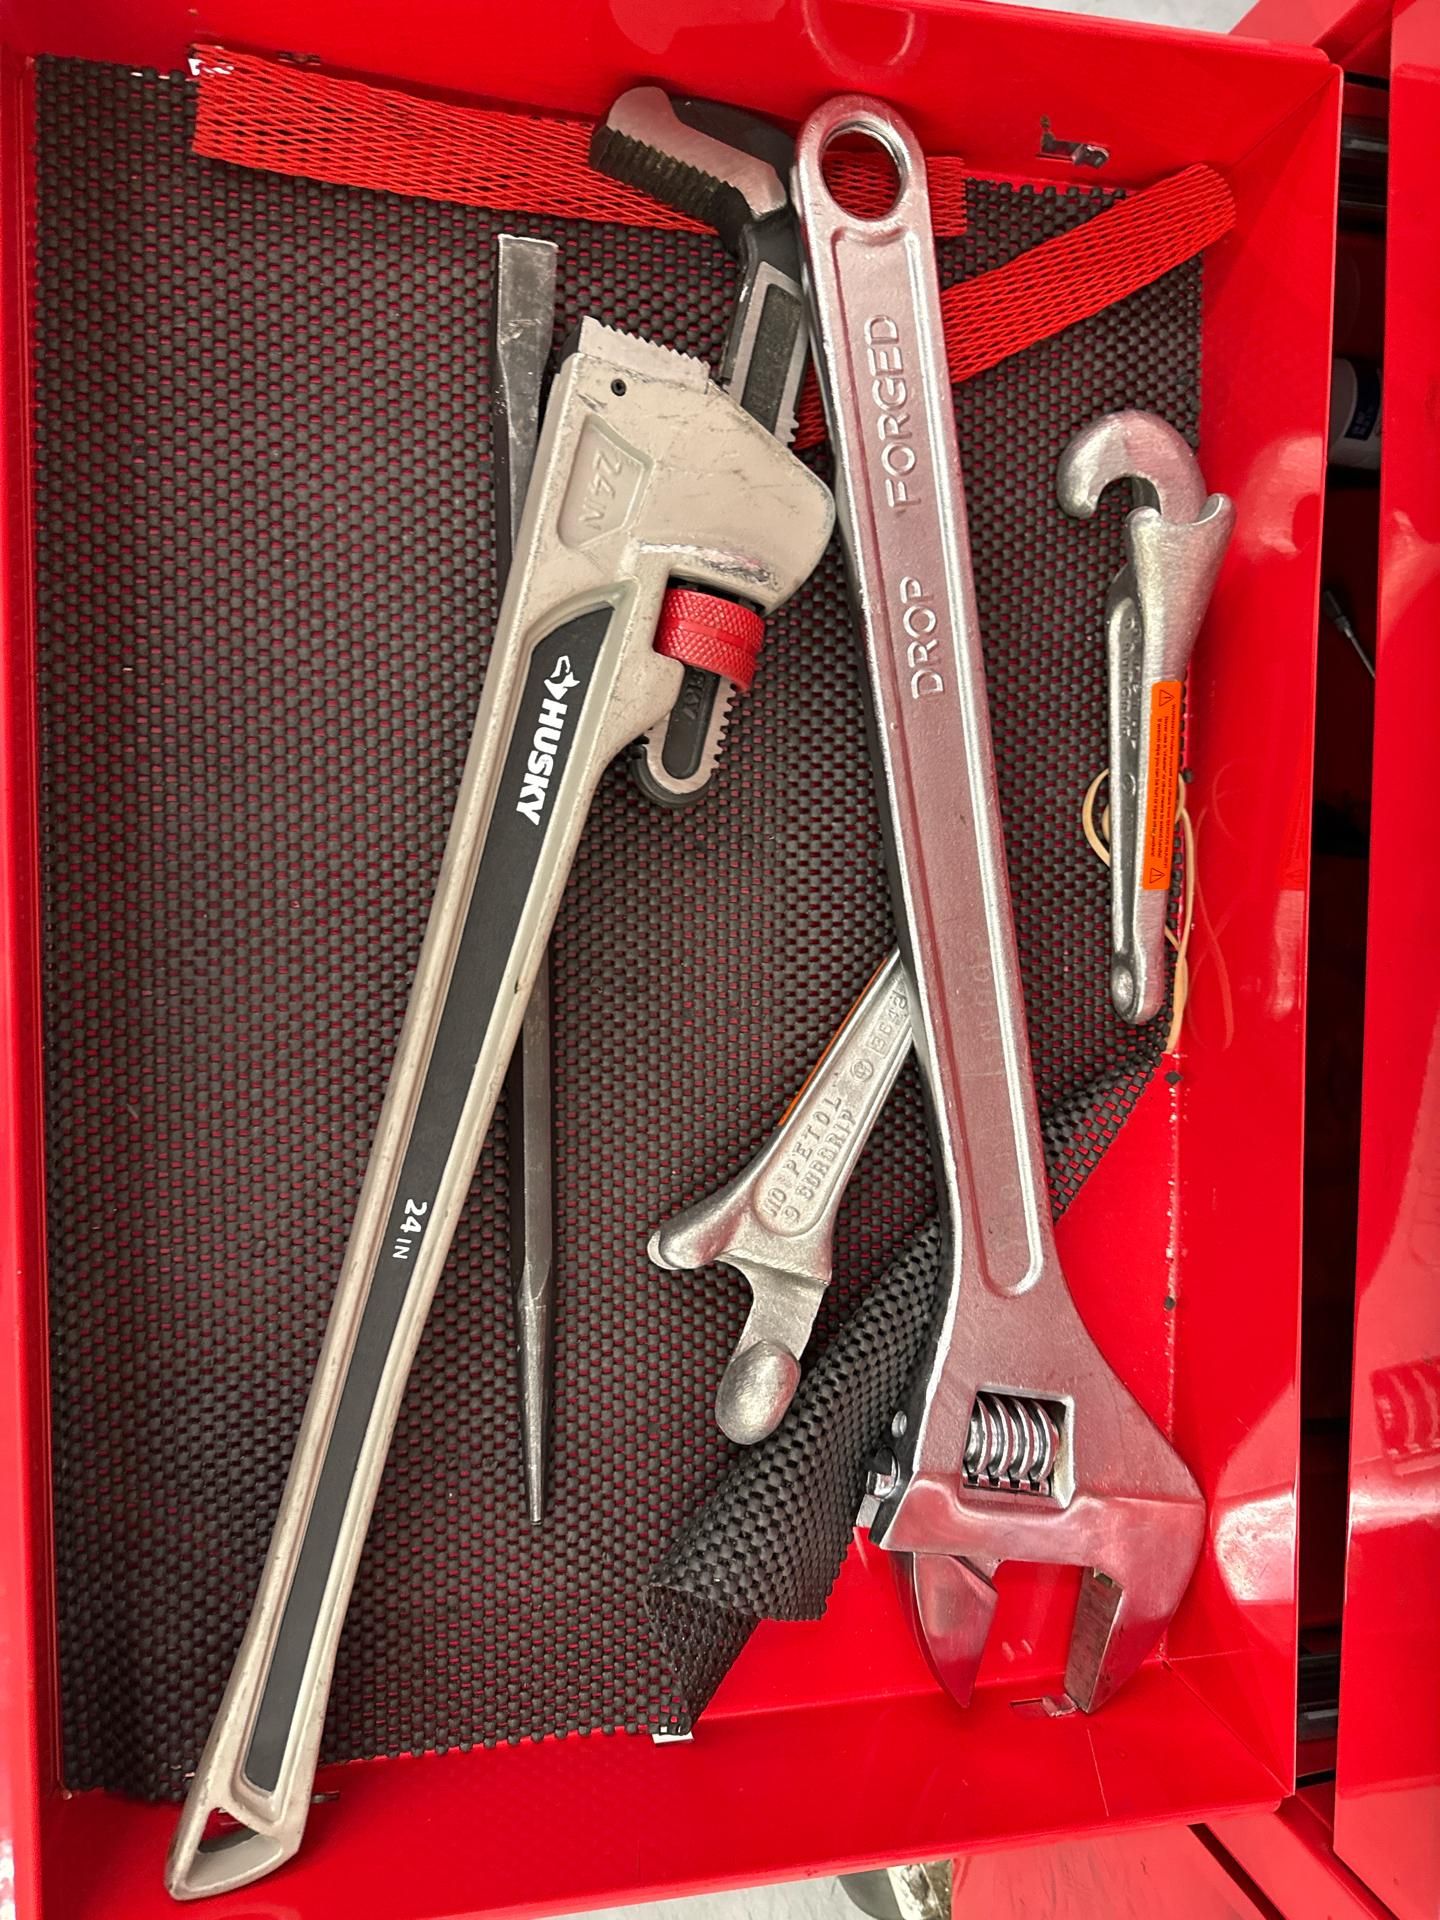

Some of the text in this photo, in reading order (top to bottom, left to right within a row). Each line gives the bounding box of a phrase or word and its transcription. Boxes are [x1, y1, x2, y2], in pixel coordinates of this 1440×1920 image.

[578, 449, 622, 531] 24 IN
[864, 314, 944, 699] DROP FORGED
[516, 698, 568, 826] HUSKY
[784, 1095, 842, 1176] PETOL
[392, 1198, 427, 1259] 24 IN
